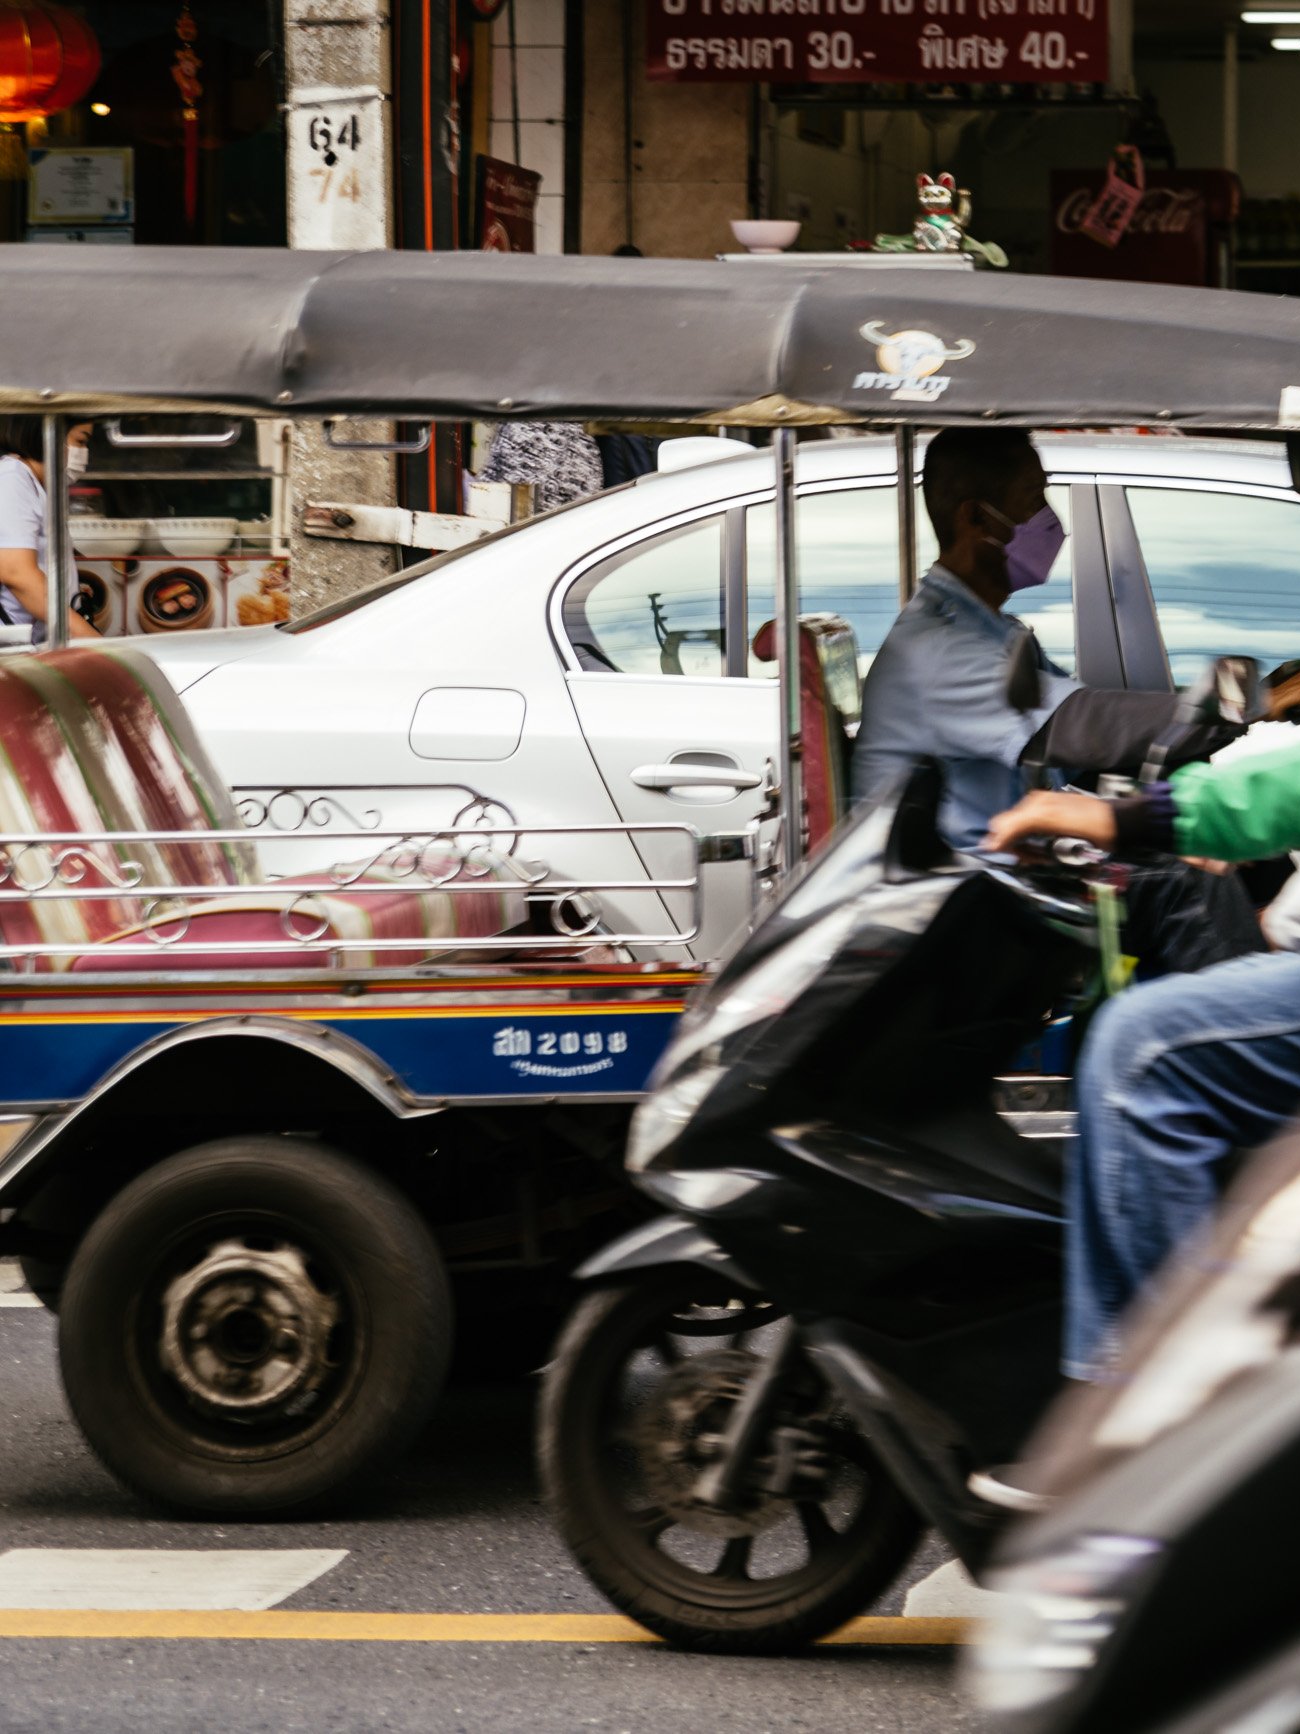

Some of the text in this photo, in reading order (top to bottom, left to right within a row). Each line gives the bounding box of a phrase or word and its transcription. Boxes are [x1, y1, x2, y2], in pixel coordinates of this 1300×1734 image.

[666, 23, 1090, 70] ธรรมดา 30.- พิเศษ 40.-
[310, 114, 361, 152] 64
[308, 167, 361, 203] 74
[536, 1031, 628, 1056] 2098
